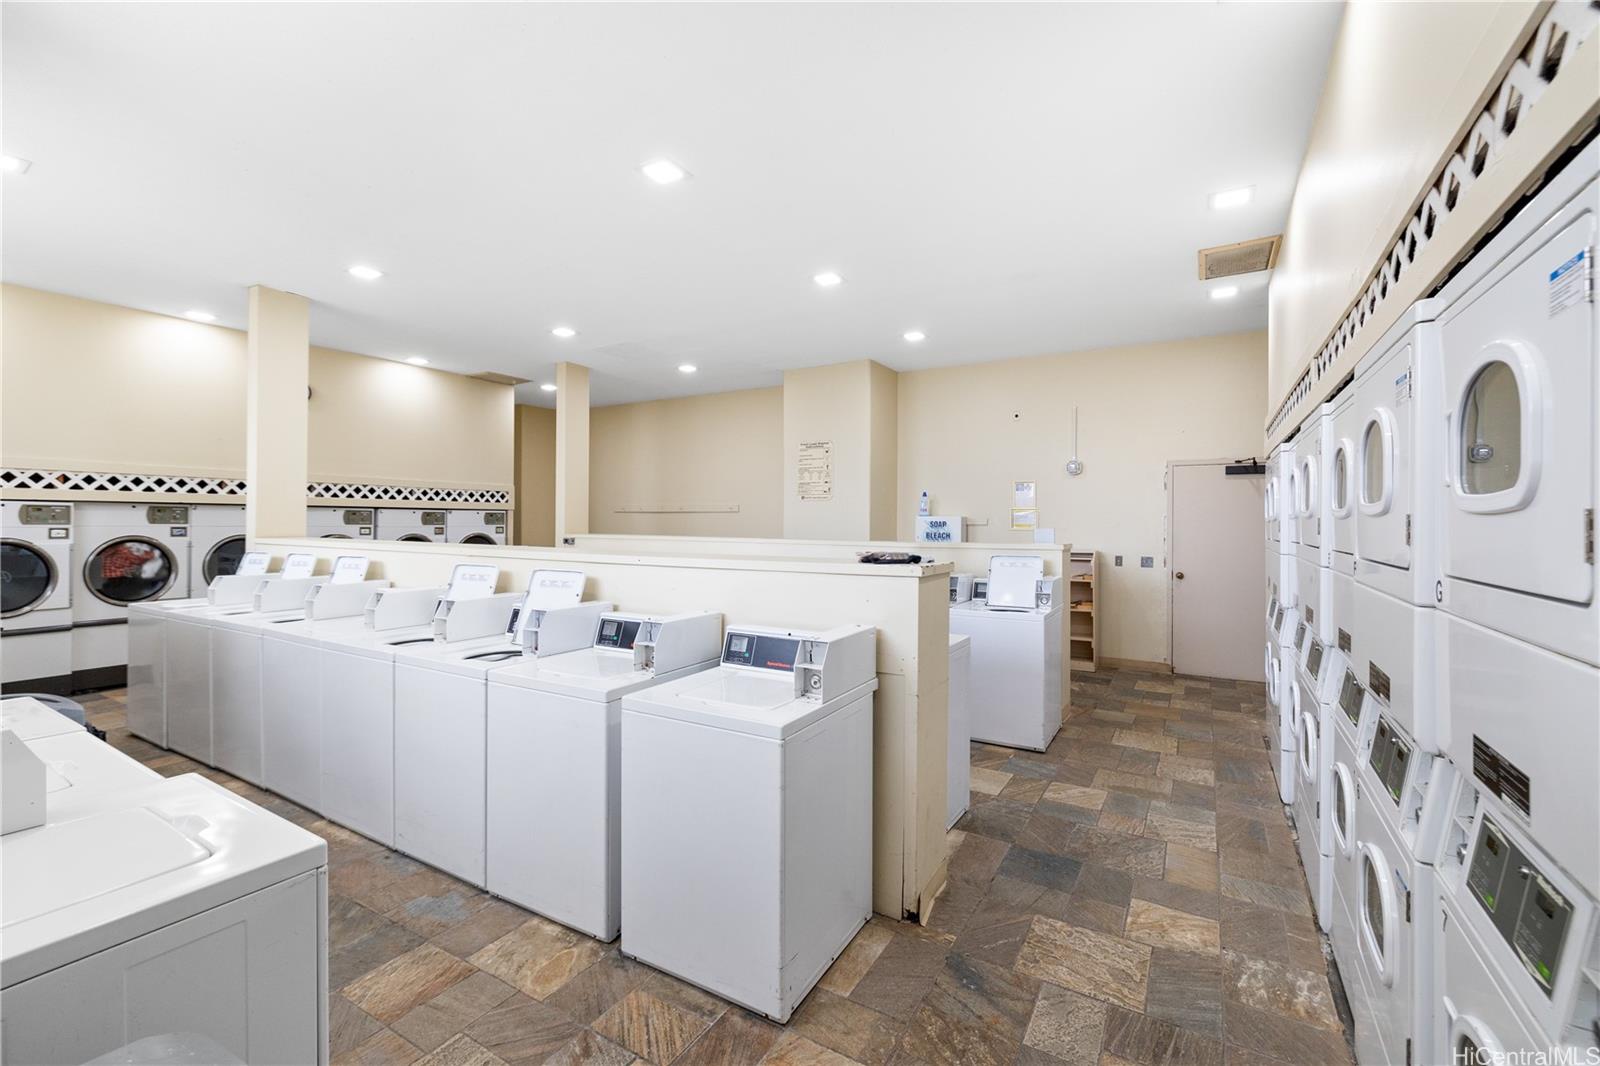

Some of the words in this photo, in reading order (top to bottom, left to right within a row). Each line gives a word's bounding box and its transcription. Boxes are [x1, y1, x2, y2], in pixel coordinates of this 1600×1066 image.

[929, 520, 947, 528] SOAP
[925, 532, 951, 540] BLEACH
[1435, 579, 1443, 603] G
